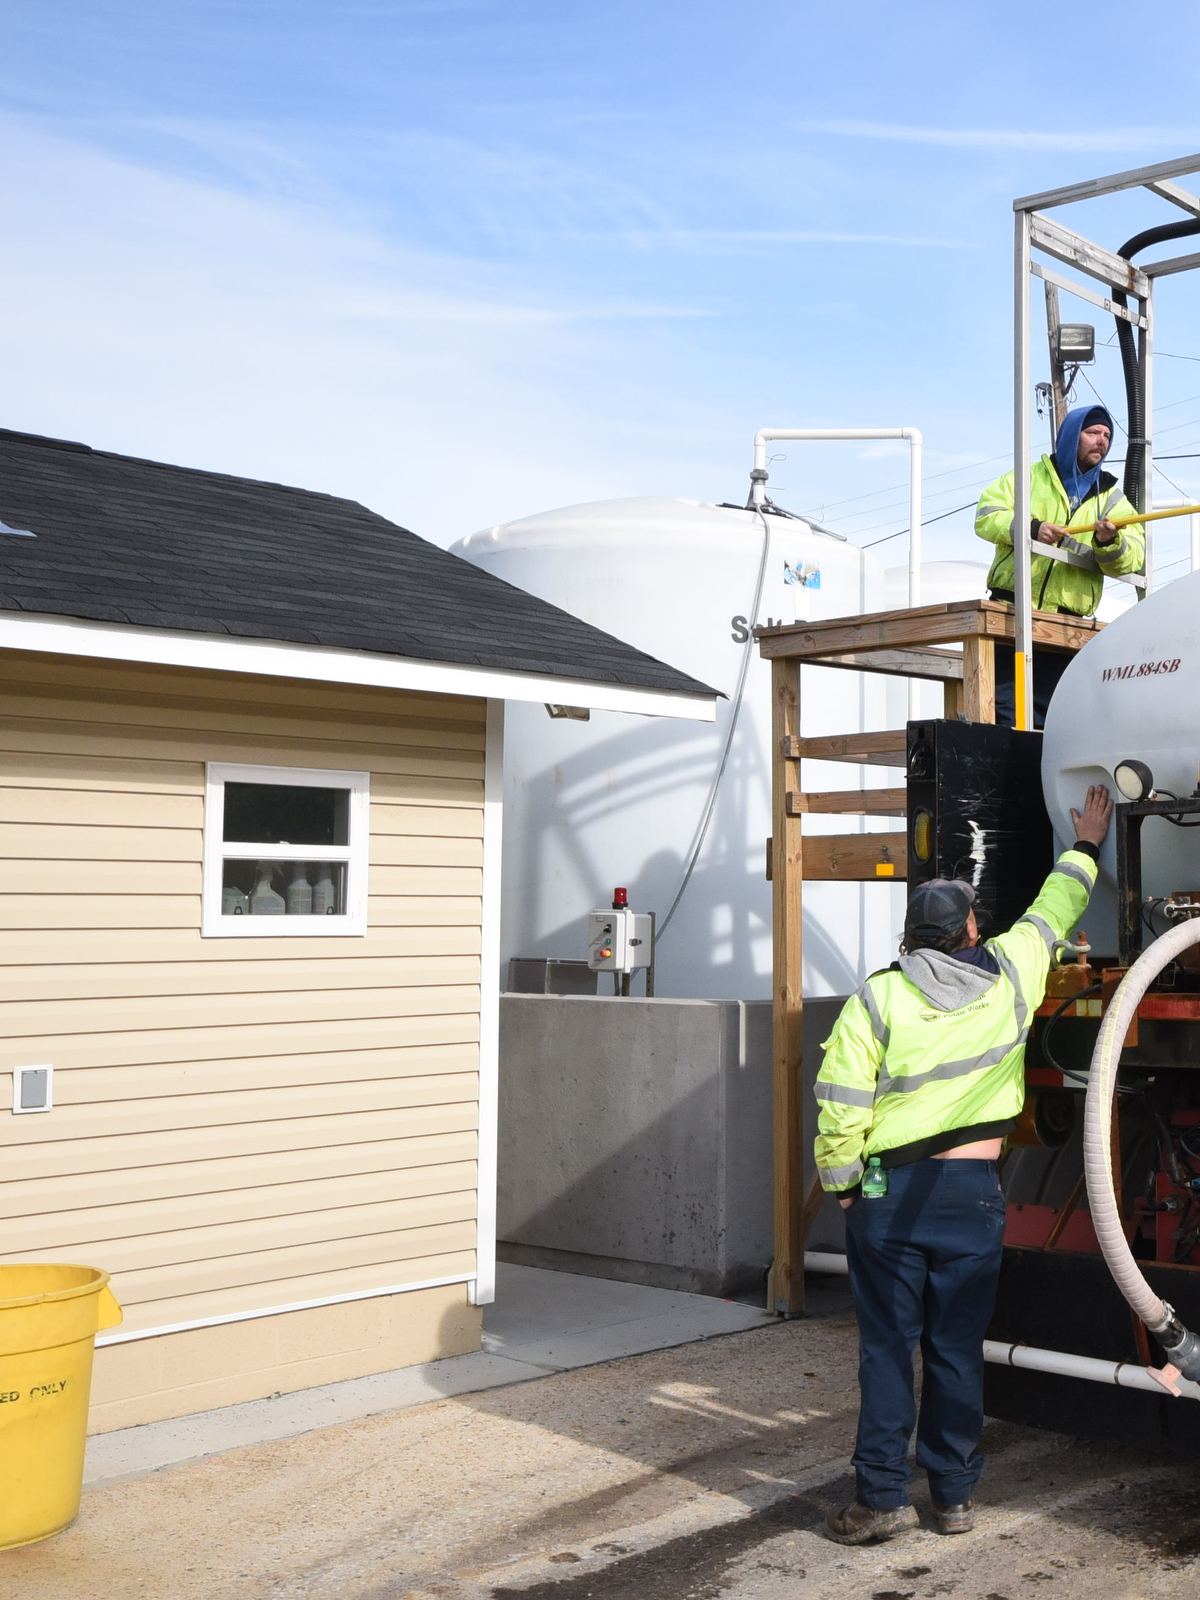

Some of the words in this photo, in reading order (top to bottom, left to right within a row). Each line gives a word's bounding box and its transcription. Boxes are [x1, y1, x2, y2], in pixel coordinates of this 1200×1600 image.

[1101, 658, 1182, 683] WML884SB
[967, 1002, 990, 1012] Works
[29, 1380, 67, 1399] ONLY
